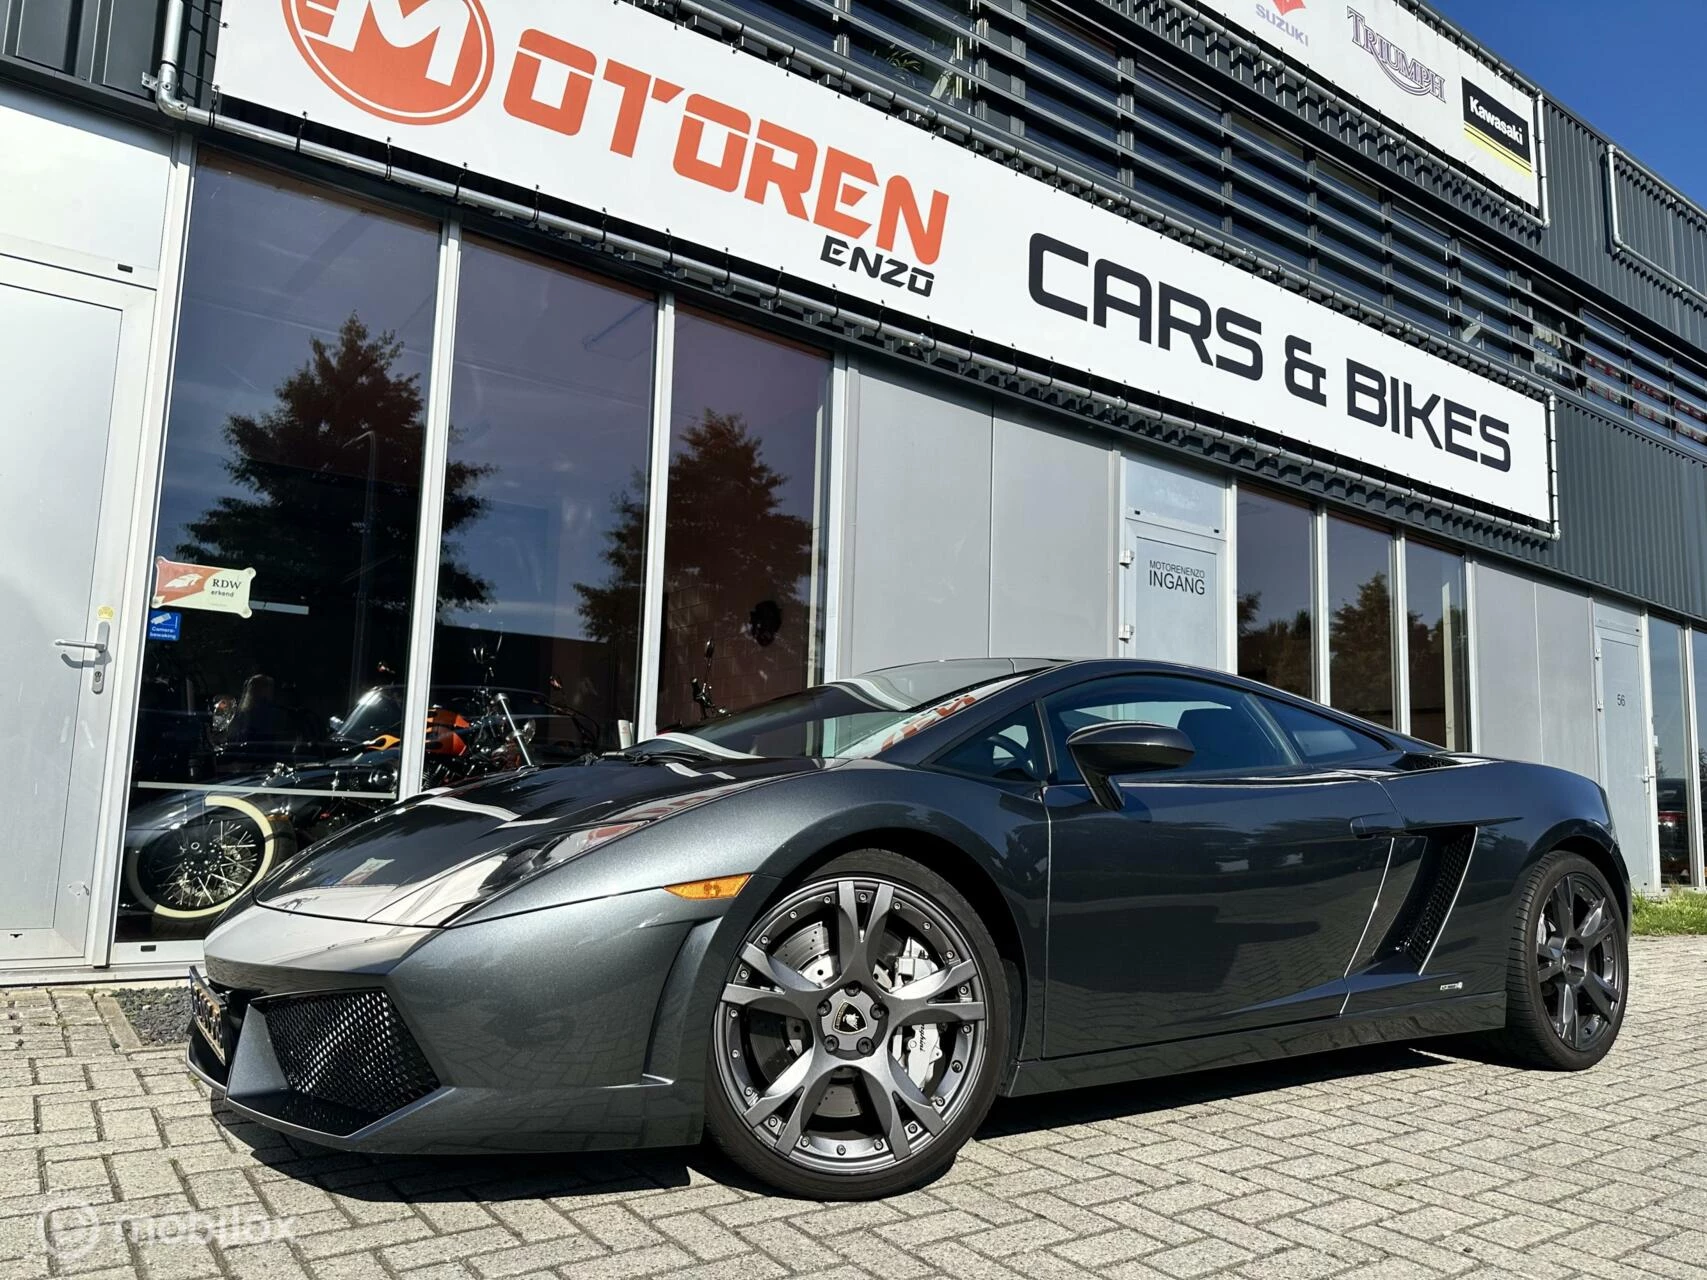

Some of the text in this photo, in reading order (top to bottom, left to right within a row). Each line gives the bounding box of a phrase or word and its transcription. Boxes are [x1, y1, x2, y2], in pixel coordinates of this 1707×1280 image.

[1256, 4, 1308, 47] SUZUKI
[1347, 5, 1446, 103] TRIUMPH
[1469, 95, 1523, 145] Kawasaki
[820, 234, 935, 297] ENZO
[1028, 233, 1511, 473] CARS & BIKES
[212, 578, 241, 590] RDW
[1149, 560, 1205, 579] MOTORENENZO
[1149, 570, 1205, 596] INGANG
[211, 589, 235, 598] erkend
